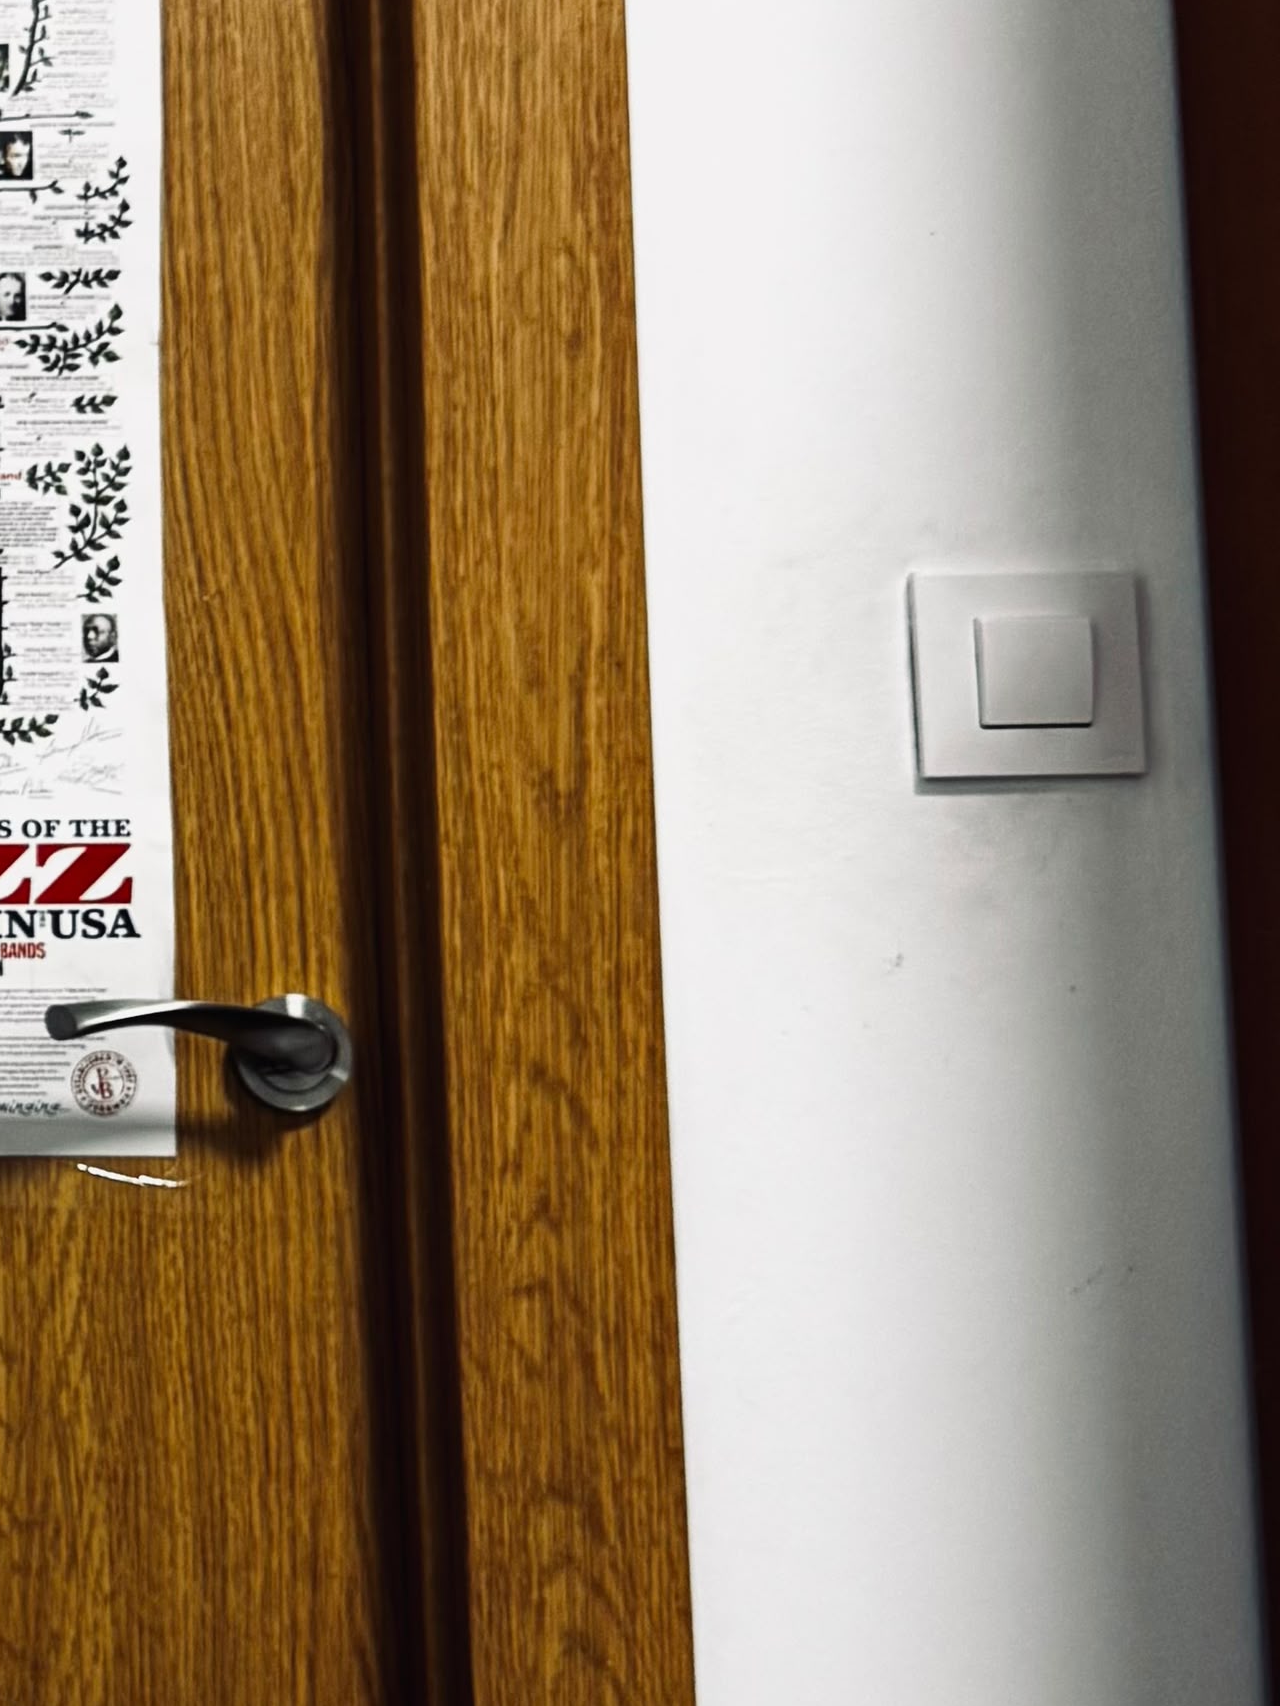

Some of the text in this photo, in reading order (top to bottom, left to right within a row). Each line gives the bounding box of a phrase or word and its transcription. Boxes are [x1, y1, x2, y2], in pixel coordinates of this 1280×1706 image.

[22, 820, 60, 838] OF
[69, 819, 131, 837] THE
[47, 909, 141, 939] USA
[0, 943, 45, 959] BANDS
